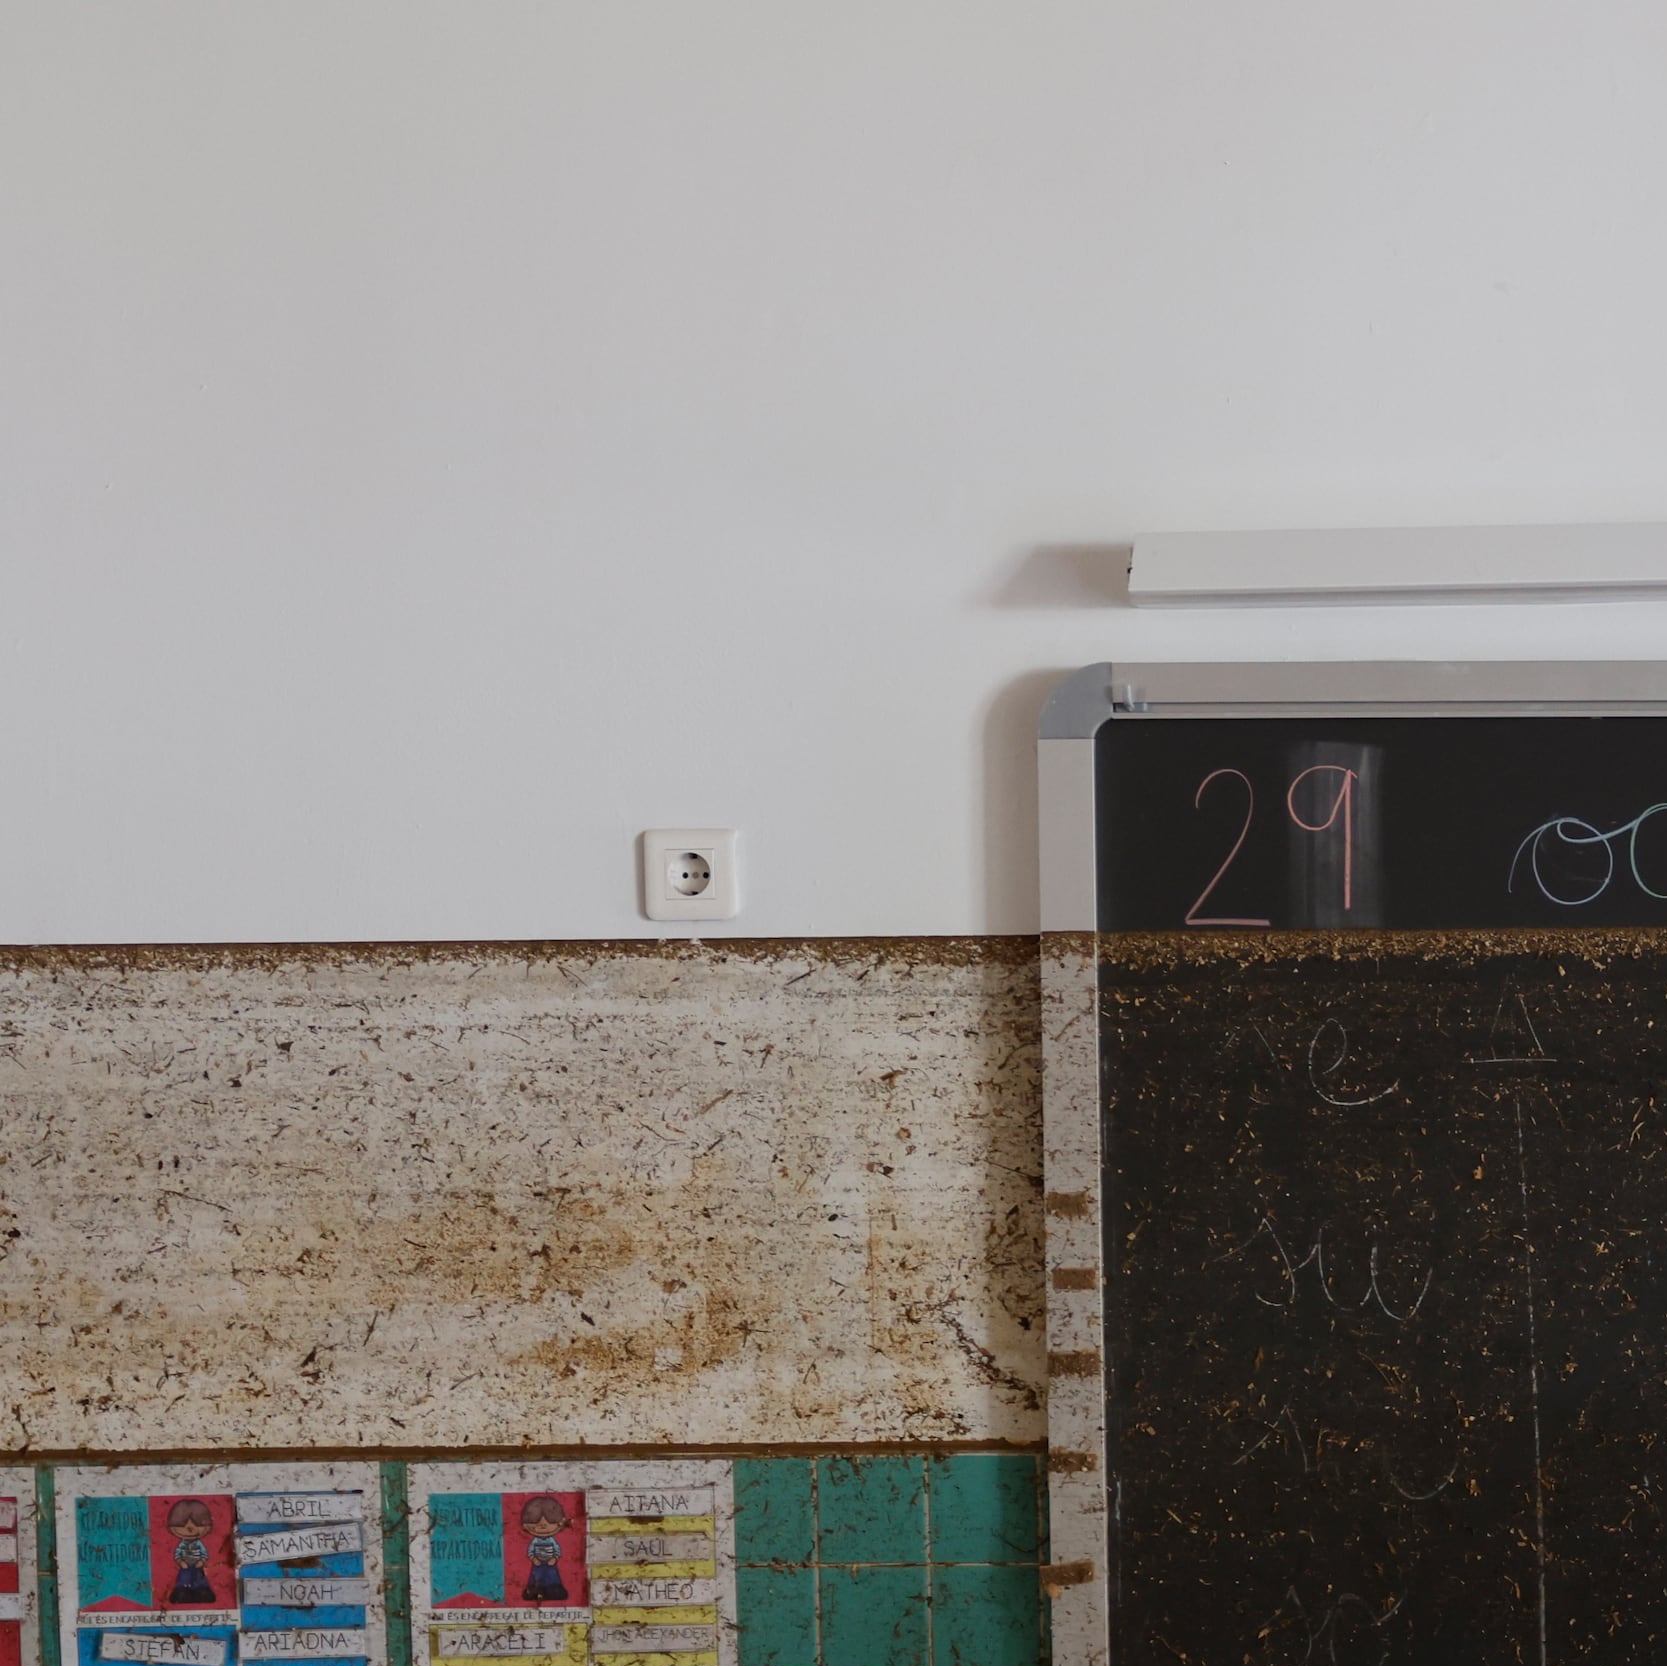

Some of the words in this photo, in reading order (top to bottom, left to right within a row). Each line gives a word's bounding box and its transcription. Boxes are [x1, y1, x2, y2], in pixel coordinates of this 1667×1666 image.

[1184, 764, 1358, 926] 29
[267, 1500, 331, 1518] ABRIL
[609, 1494, 689, 1513] AITANA
[243, 1531, 350, 1559] SAMANTHA
[279, 1584, 335, 1601] NOAH
[614, 1583, 694, 1601] MATHEO
[124, 1639, 200, 1660] STEFAN
[254, 1632, 349, 1651] ARIADNA
[457, 1633, 546, 1651] ARACELI
